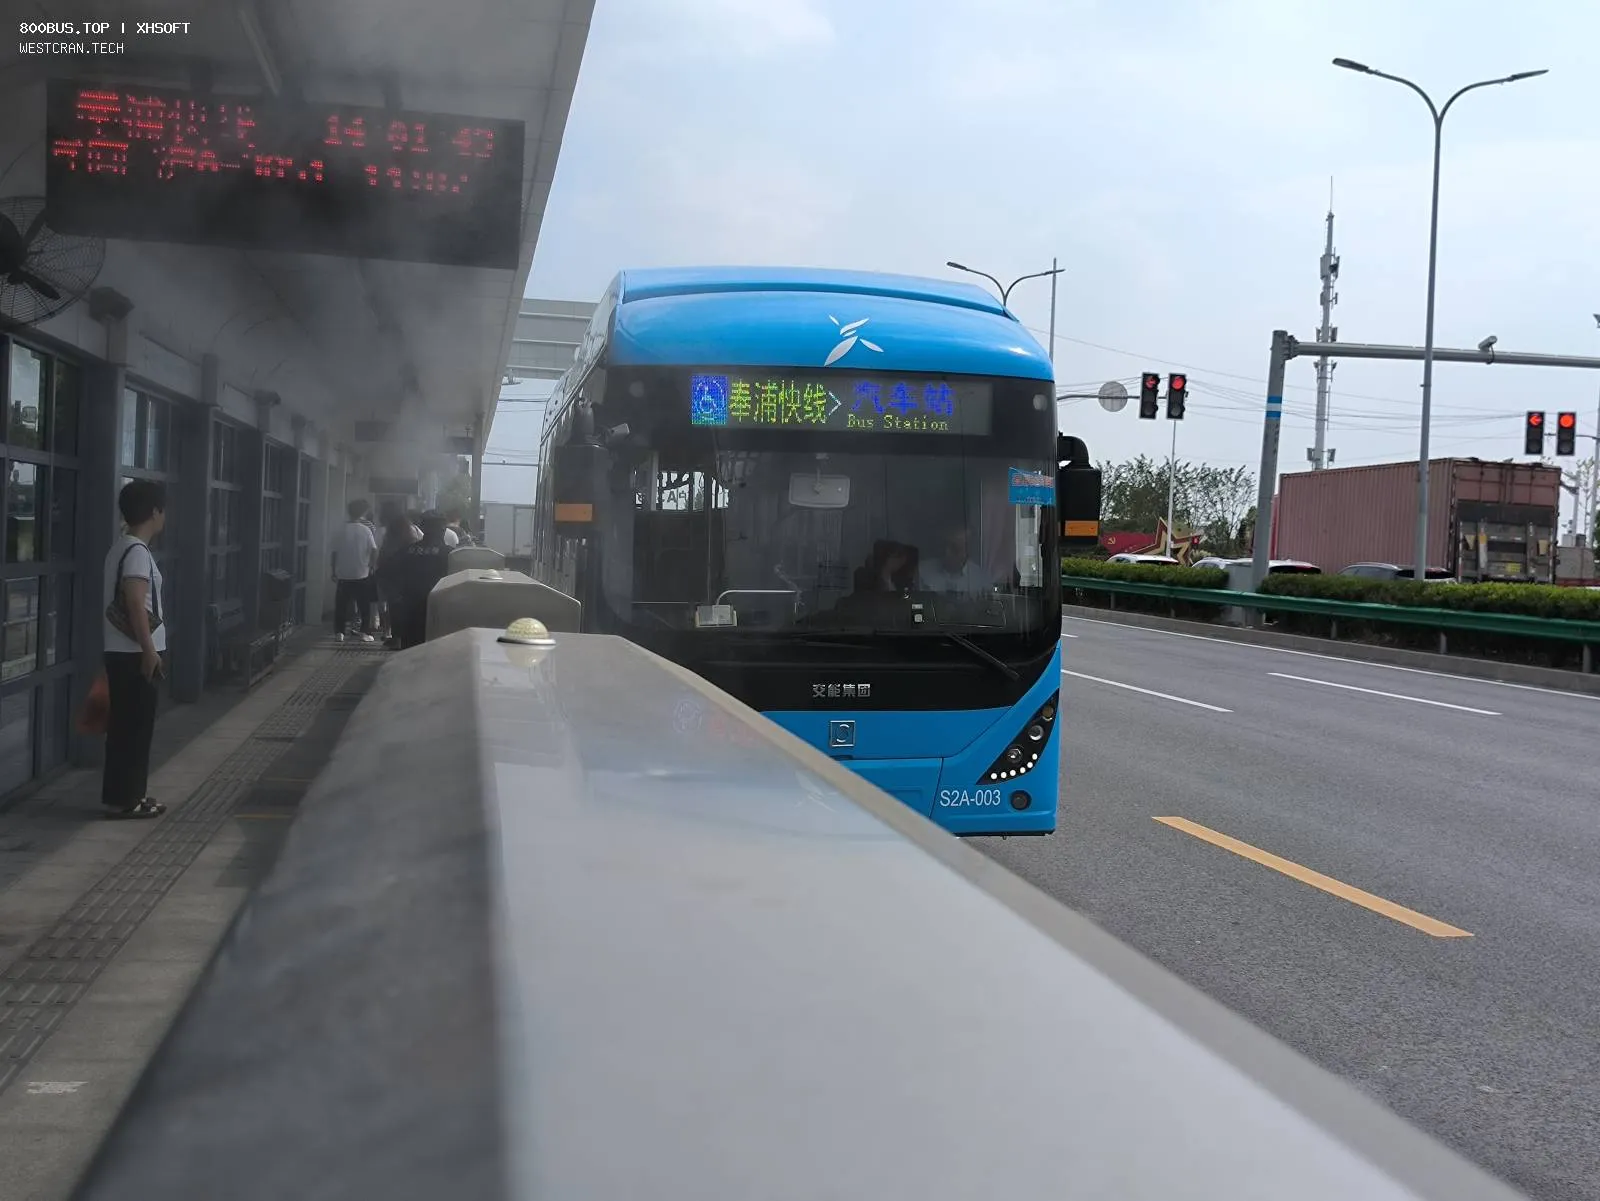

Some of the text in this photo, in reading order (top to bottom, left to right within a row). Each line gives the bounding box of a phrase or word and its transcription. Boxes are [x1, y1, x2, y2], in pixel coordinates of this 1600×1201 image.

[729, 378, 827, 424] 奉浦快线
[850, 380, 956, 415] 汽车站
[847, 414, 949, 431] Bus Station
[812, 683, 871, 698] 交能集团
[939, 789, 1001, 807] S2A-003
